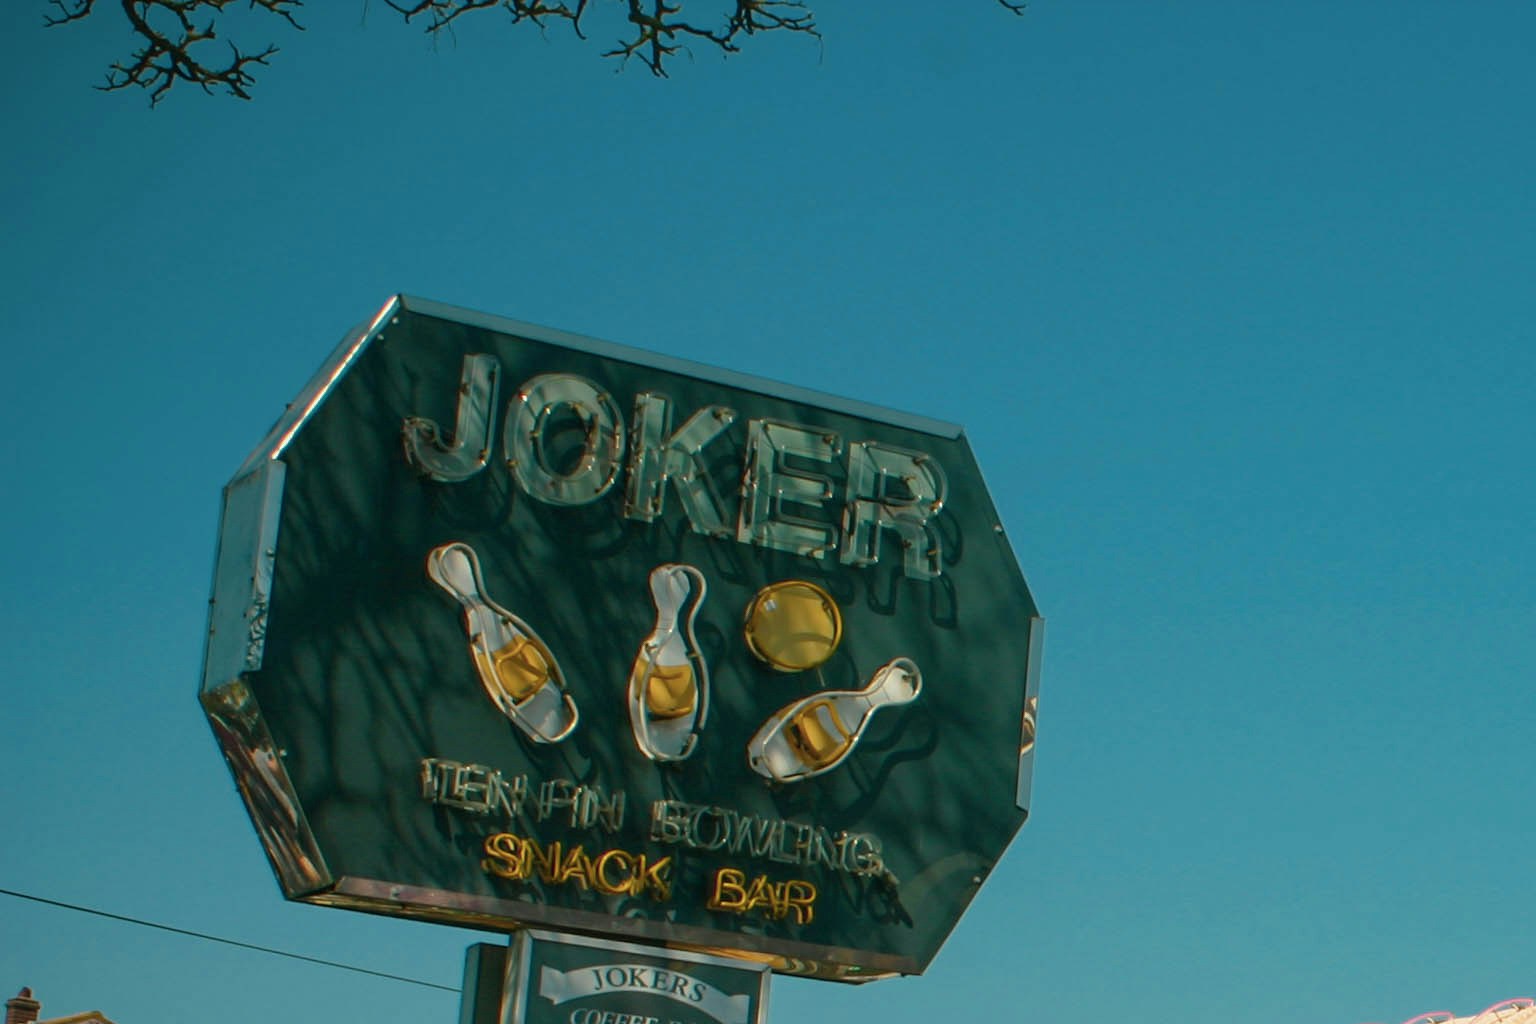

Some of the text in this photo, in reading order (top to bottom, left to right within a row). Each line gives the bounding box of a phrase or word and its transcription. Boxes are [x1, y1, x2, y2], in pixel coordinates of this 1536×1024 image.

[401, 353, 948, 580] JOKER
[481, 833, 817, 926] SNACK BAR
[651, 799, 884, 877] BOWLING
[592, 967, 707, 1001] JOKERS
